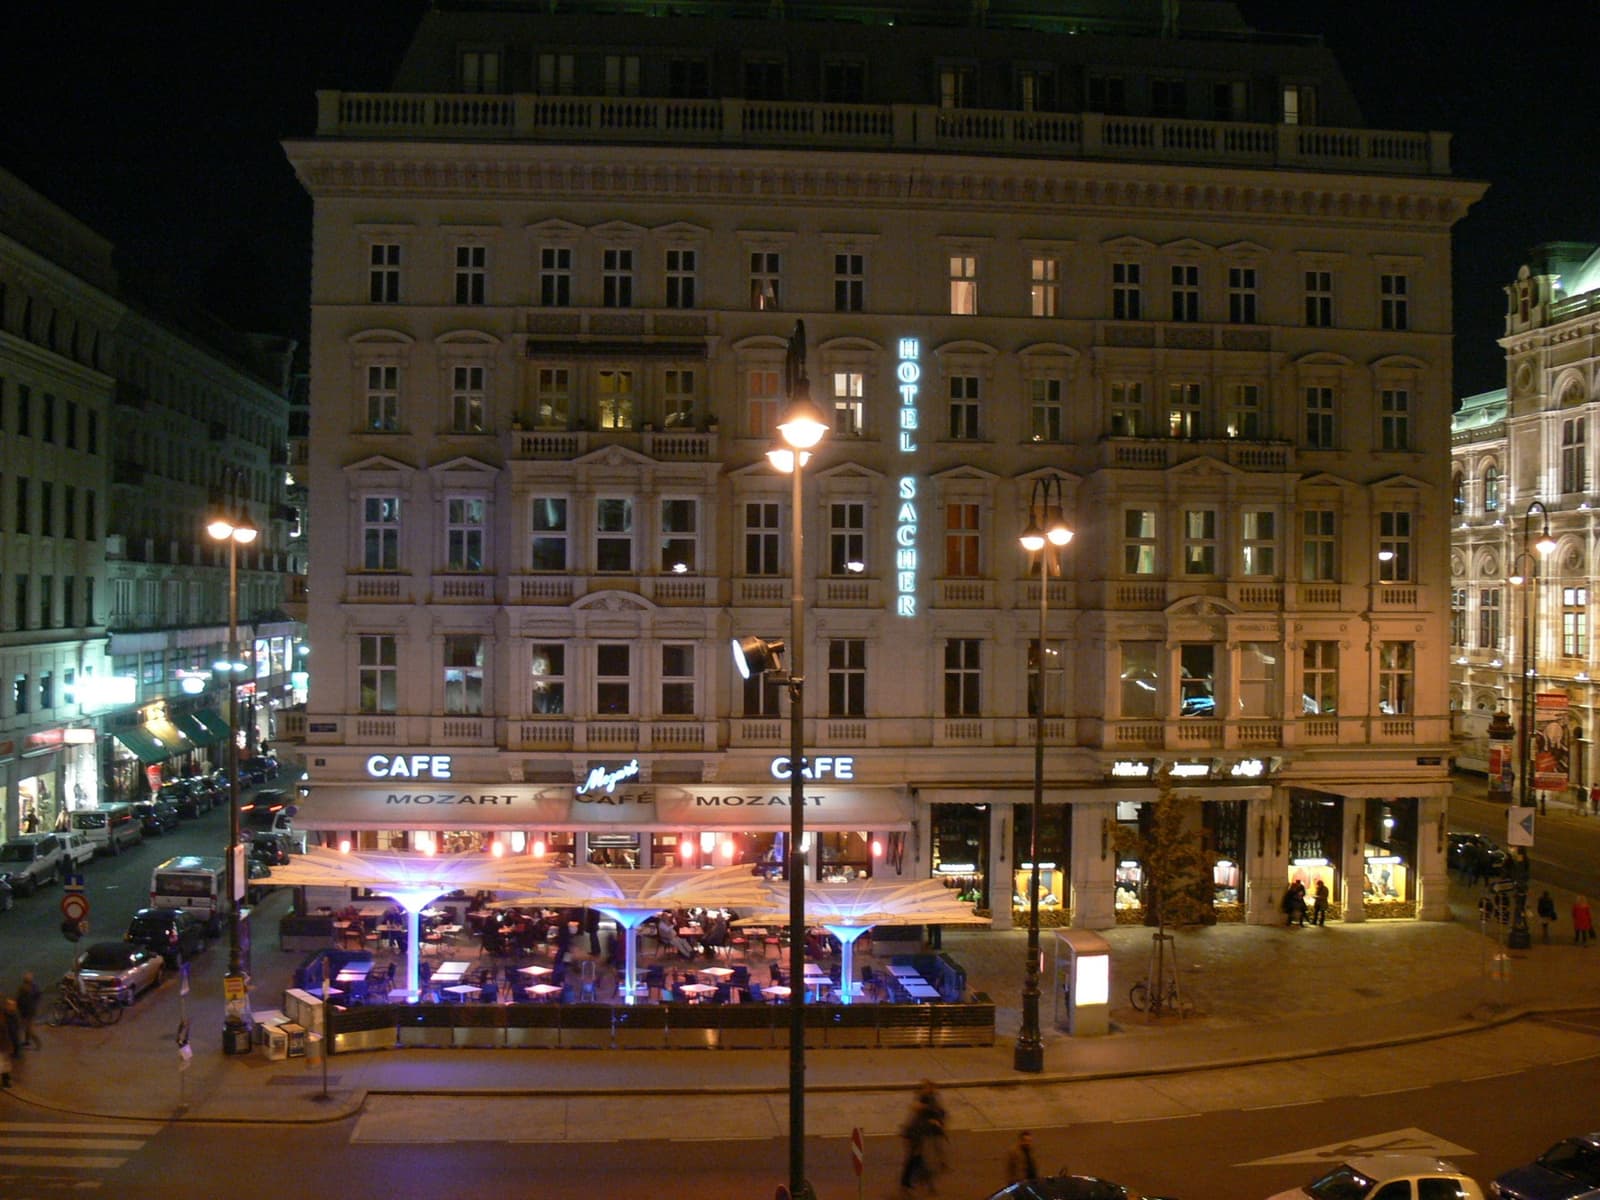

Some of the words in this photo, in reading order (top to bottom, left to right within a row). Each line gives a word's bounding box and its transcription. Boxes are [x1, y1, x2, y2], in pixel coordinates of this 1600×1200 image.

[897, 337, 920, 452] HOTEL
[896, 476, 918, 616] SACHER
[367, 754, 452, 779] CAFE
[386, 794, 518, 805] MOZART
[696, 796, 826, 806] MOZAT
